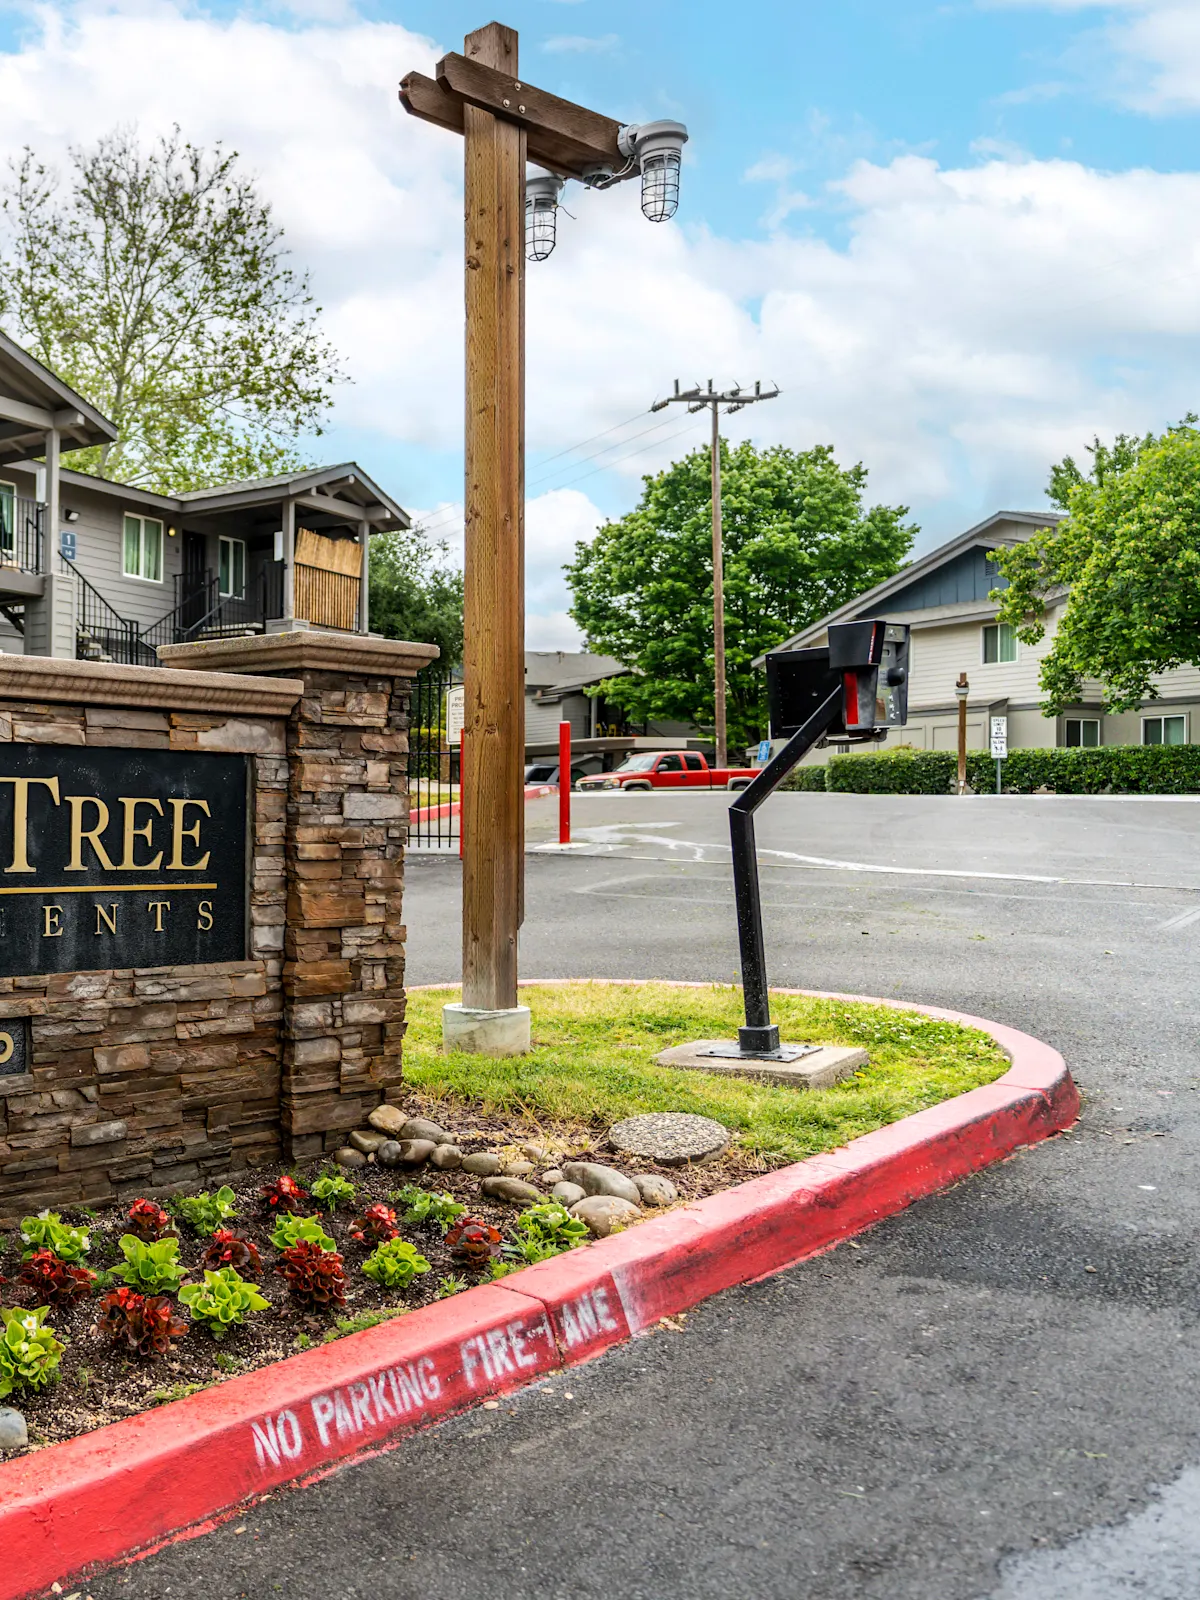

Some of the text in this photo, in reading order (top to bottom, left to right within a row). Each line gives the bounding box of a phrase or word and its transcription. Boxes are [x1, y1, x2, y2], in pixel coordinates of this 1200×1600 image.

[251, 1408, 303, 1468] NO
[310, 1355, 441, 1446] PARKING
[459, 1319, 539, 1389] FIRE
